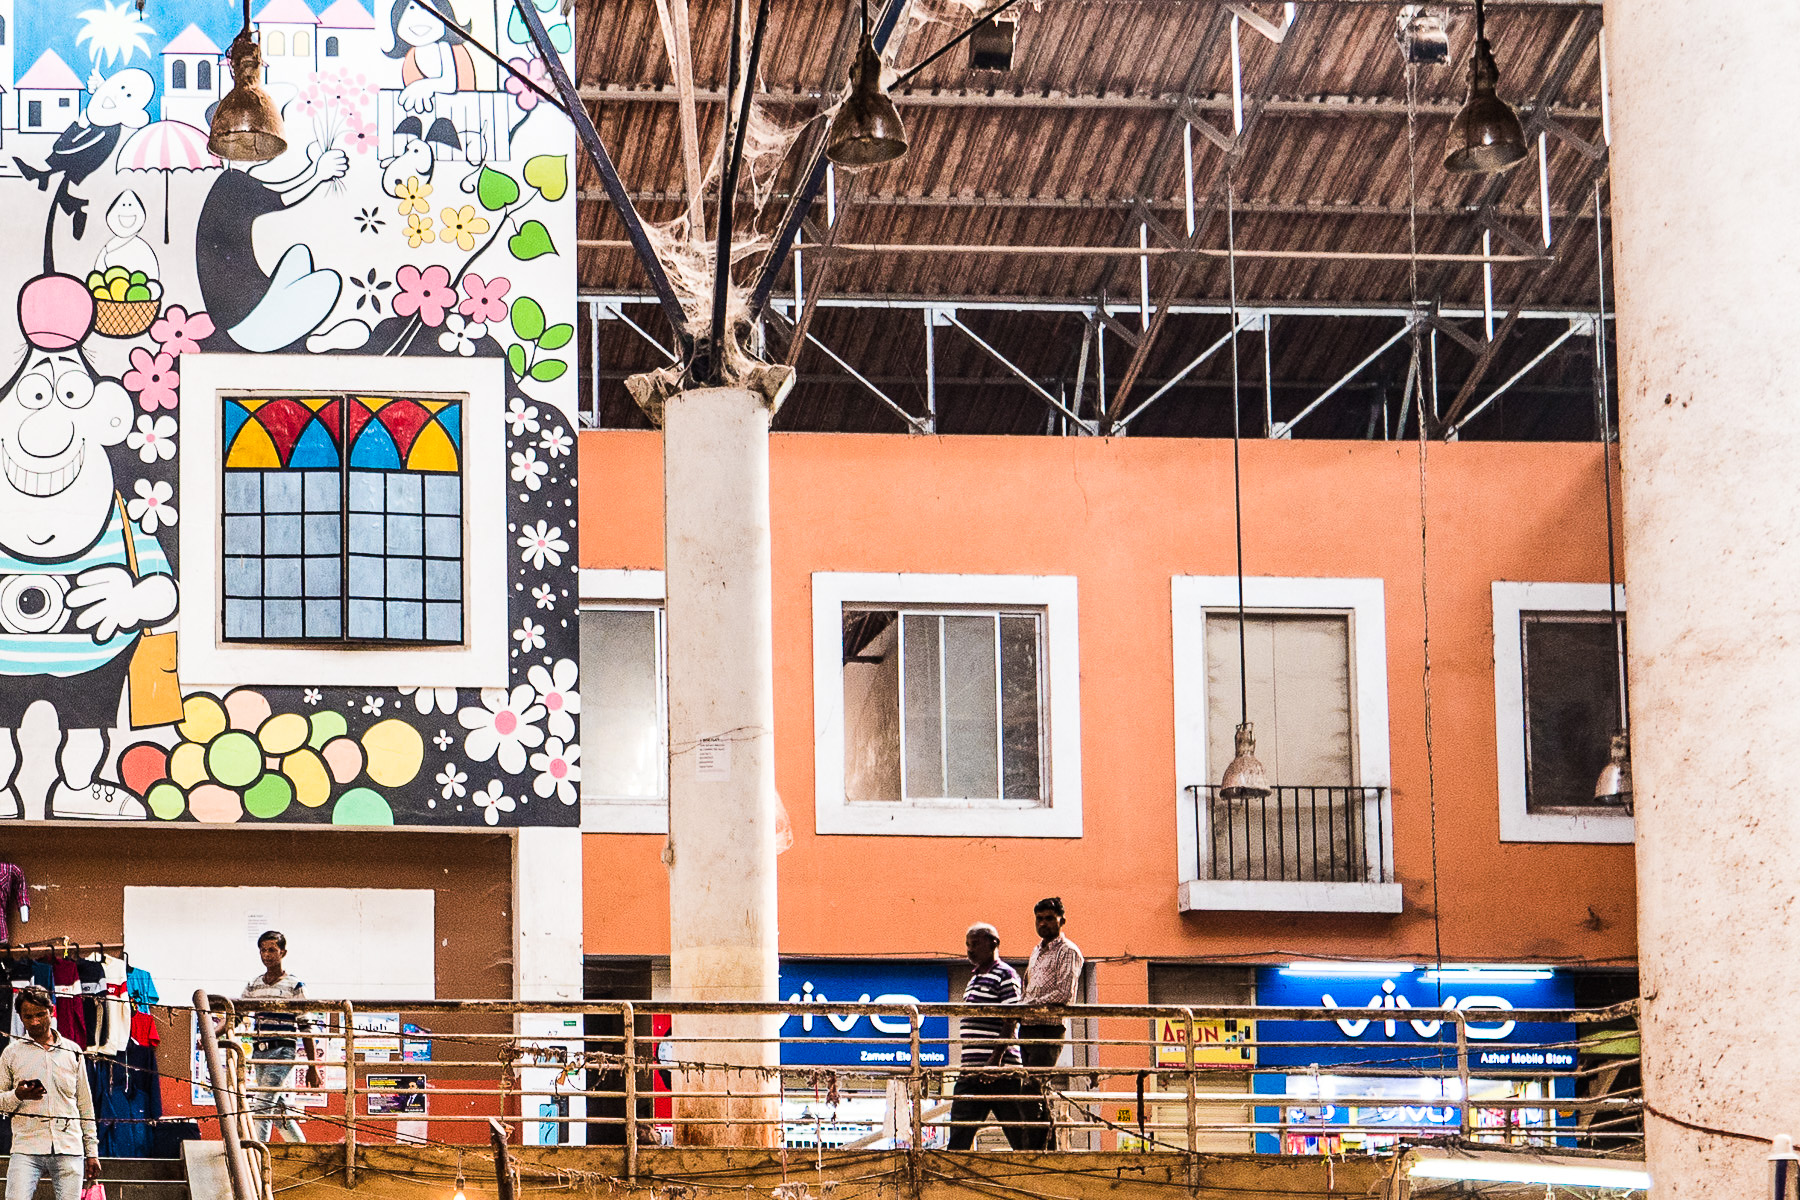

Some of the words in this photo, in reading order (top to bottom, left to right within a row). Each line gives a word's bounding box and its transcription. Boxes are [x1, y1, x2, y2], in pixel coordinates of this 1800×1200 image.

[779, 981, 925, 1033] vivo
[1322, 979, 1517, 1040] vivo
[860, 1051, 895, 1061] Zameer
[896, 1051, 944, 1061] Eleronics
[1480, 1052, 1509, 1064] Azhar
[1511, 1052, 1544, 1064] Mobile
[1546, 1052, 1572, 1064] Store
